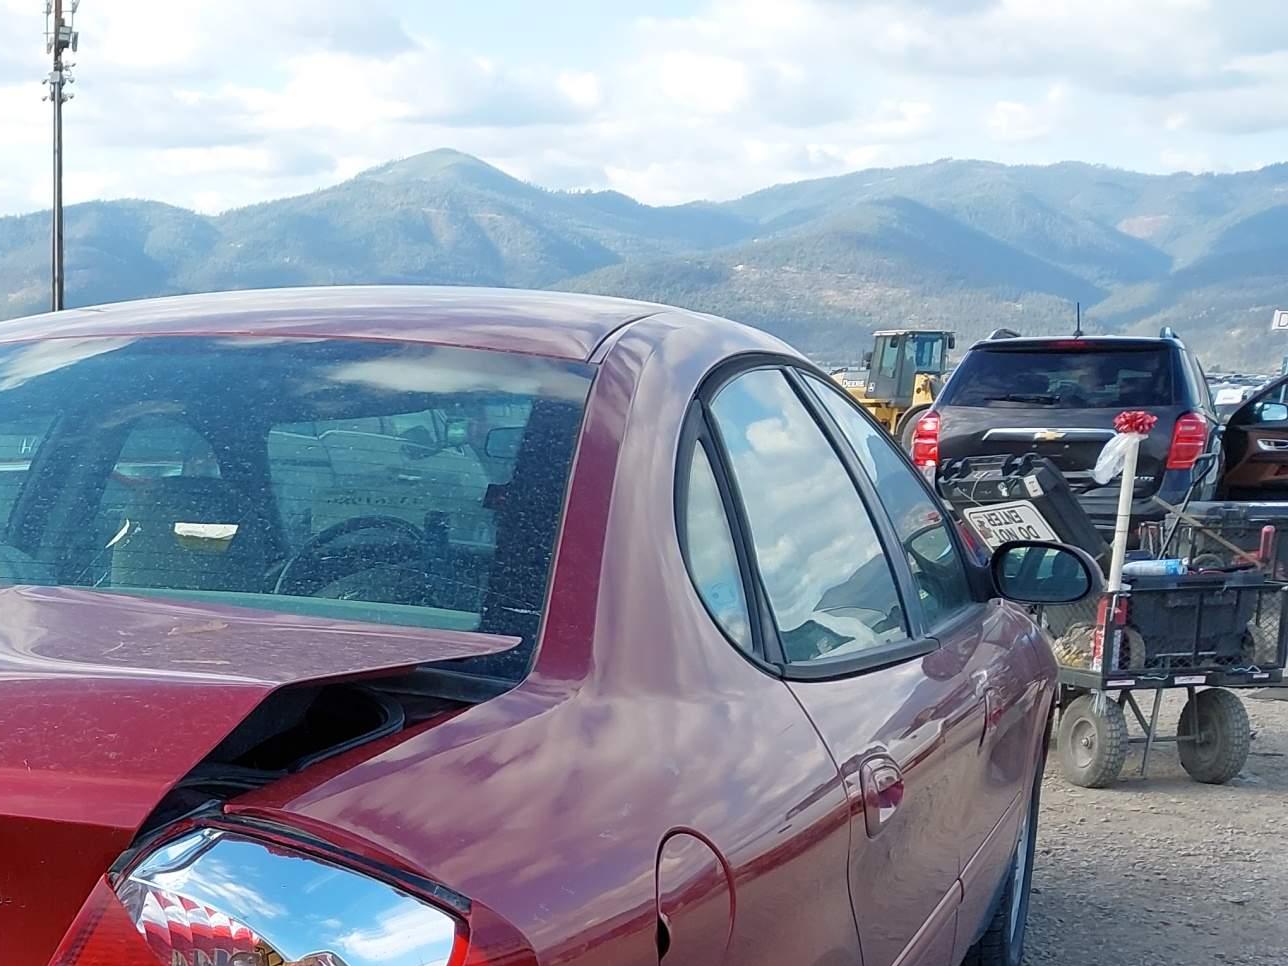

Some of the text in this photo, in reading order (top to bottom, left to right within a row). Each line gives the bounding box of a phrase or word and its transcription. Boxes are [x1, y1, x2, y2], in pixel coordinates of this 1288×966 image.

[982, 509, 1025, 527] ENTER
[992, 524, 1041, 543] DO NOT
